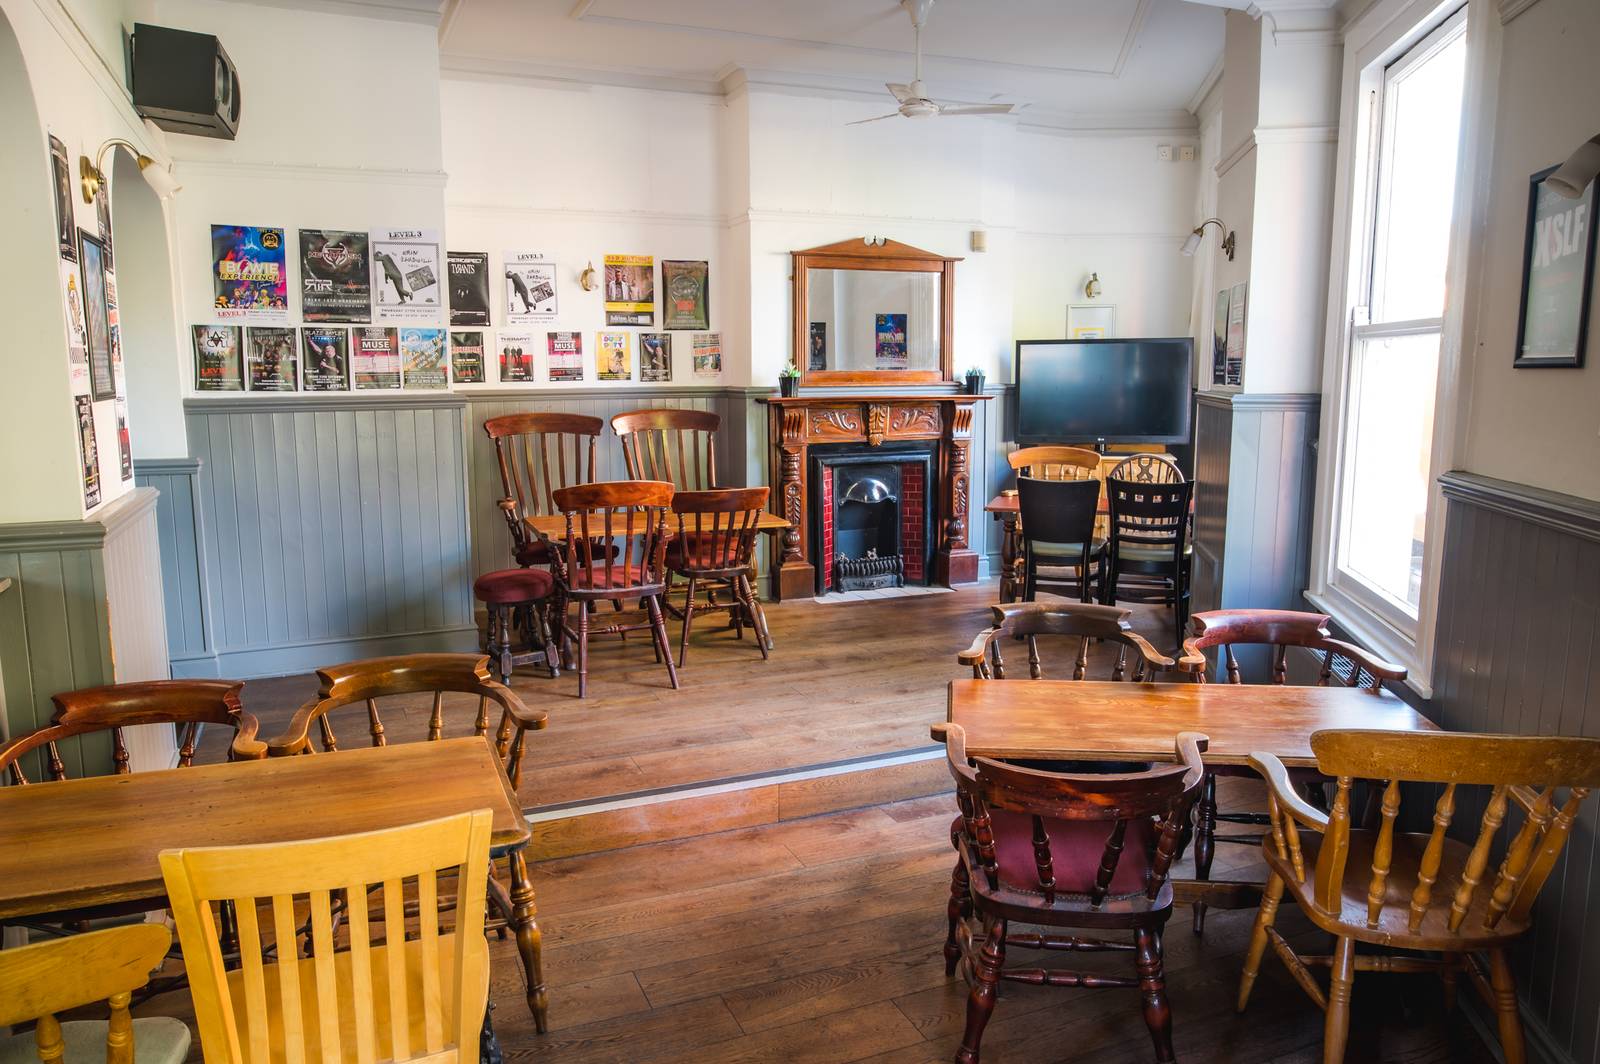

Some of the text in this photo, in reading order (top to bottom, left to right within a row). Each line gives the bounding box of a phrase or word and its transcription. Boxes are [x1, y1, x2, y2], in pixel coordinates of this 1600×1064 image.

[226, 260, 279, 274] BOWIE
[451, 263, 475, 274] TYRANTS
[362, 340, 390, 349] MUSE
[554, 341, 576, 349] MUSE
